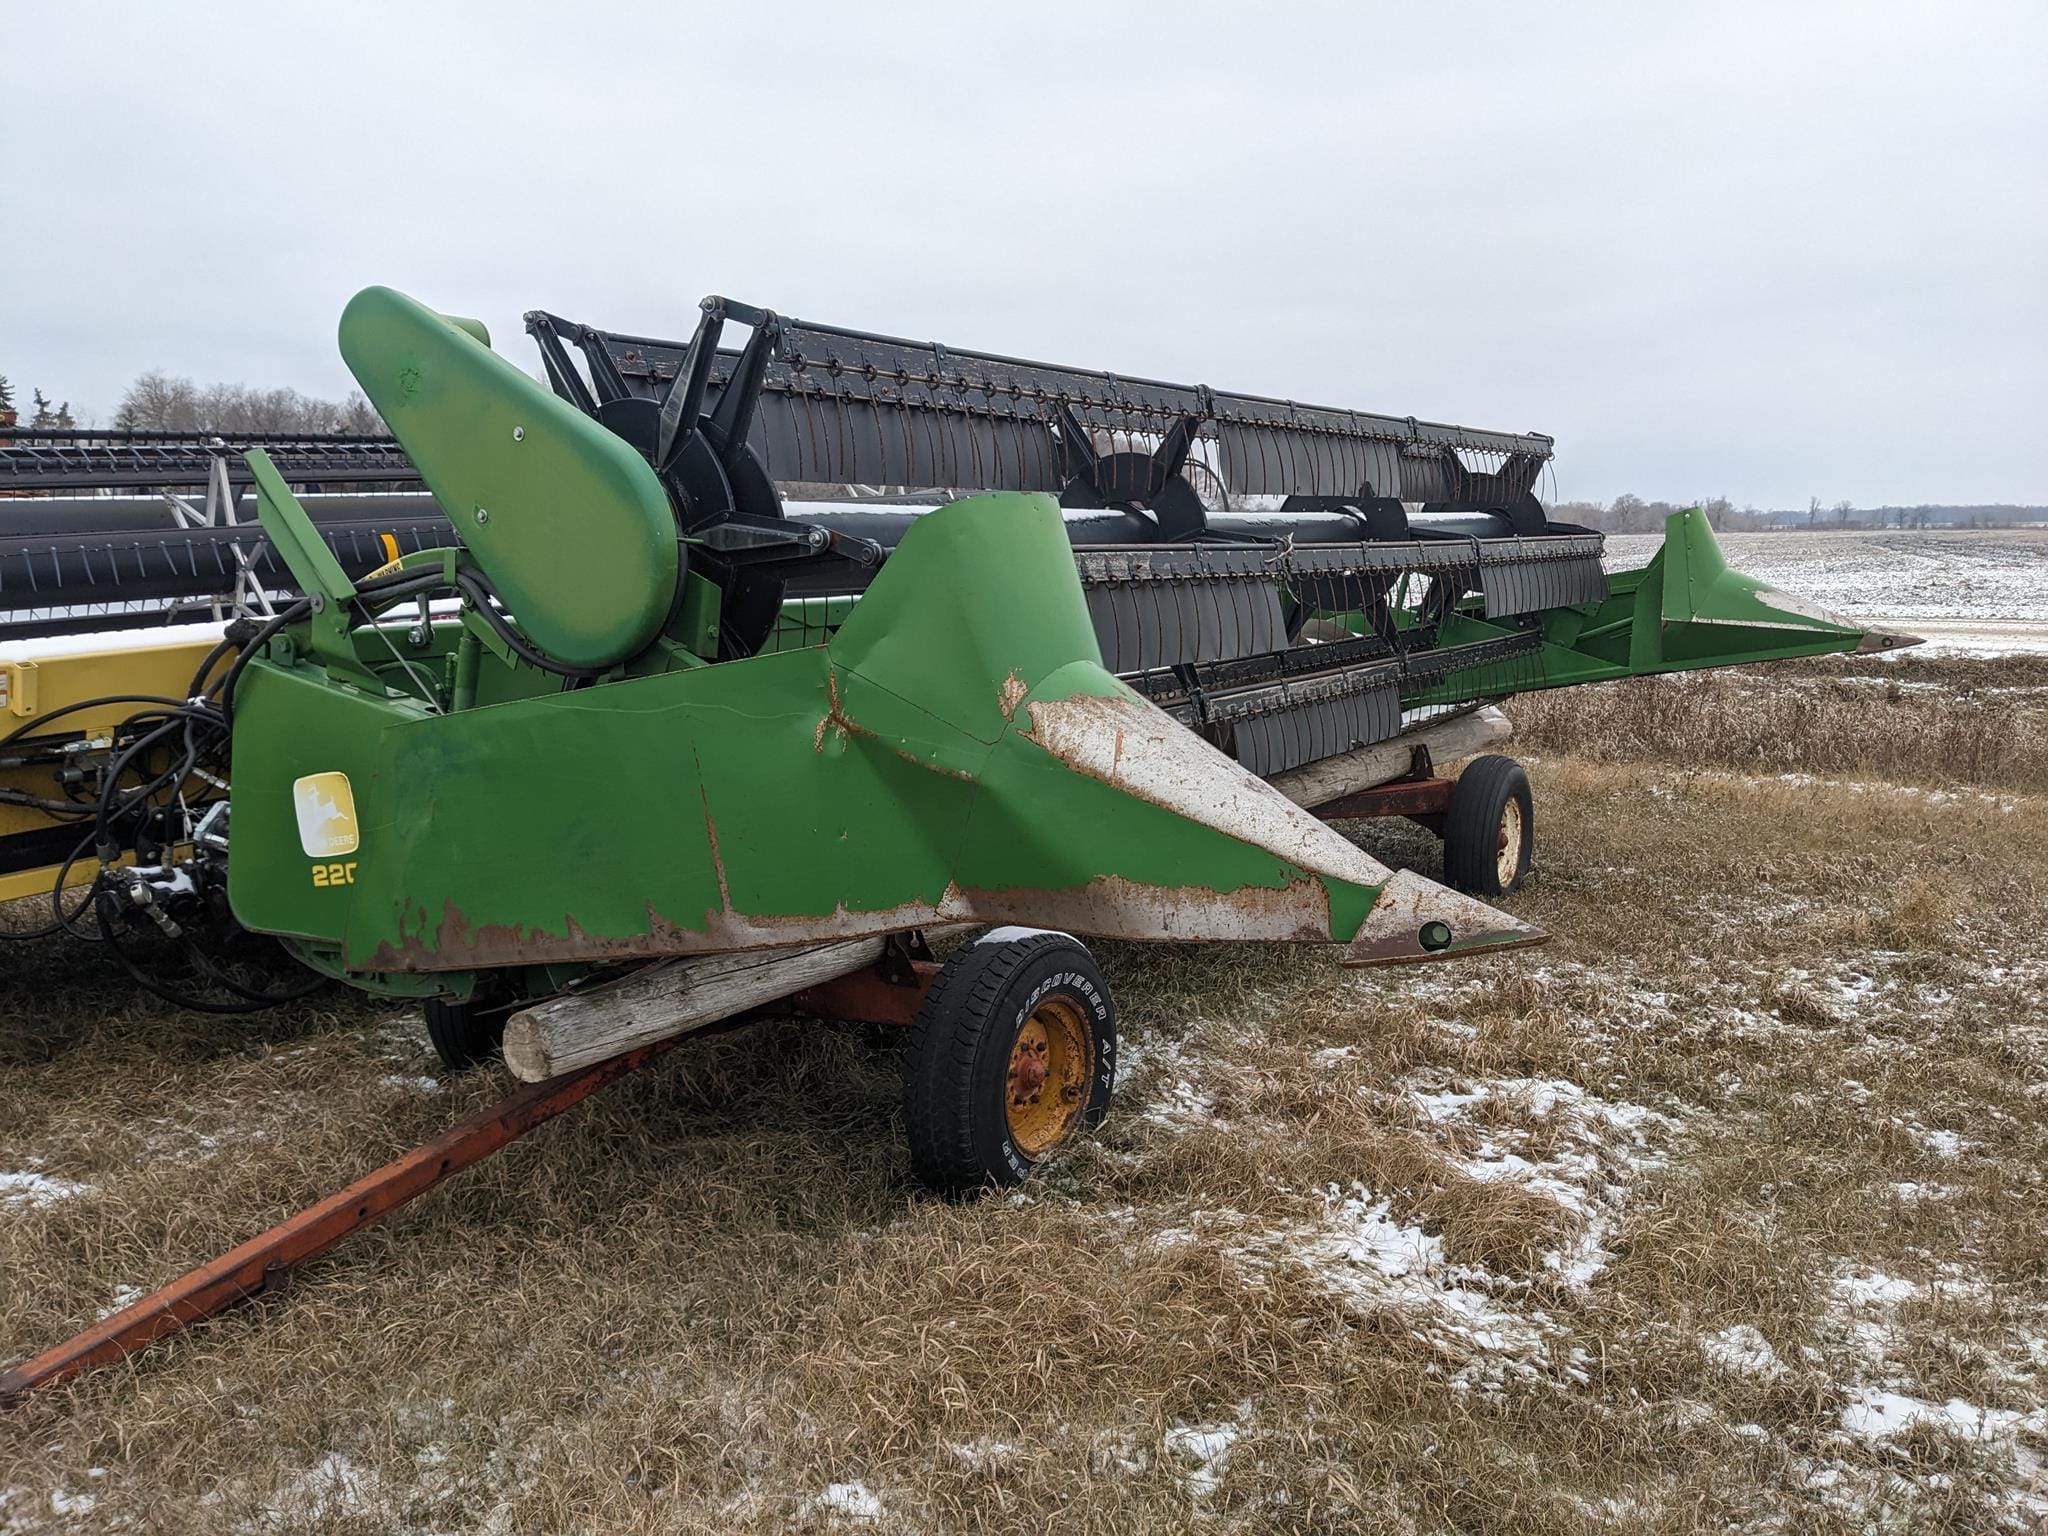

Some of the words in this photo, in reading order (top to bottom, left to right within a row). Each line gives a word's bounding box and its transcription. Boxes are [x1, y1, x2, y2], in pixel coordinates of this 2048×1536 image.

[329, 833, 355, 847] DEERE
[1016, 973, 1107, 1029] DISCOVERER
[1101, 1038, 1112, 1089] A/T
